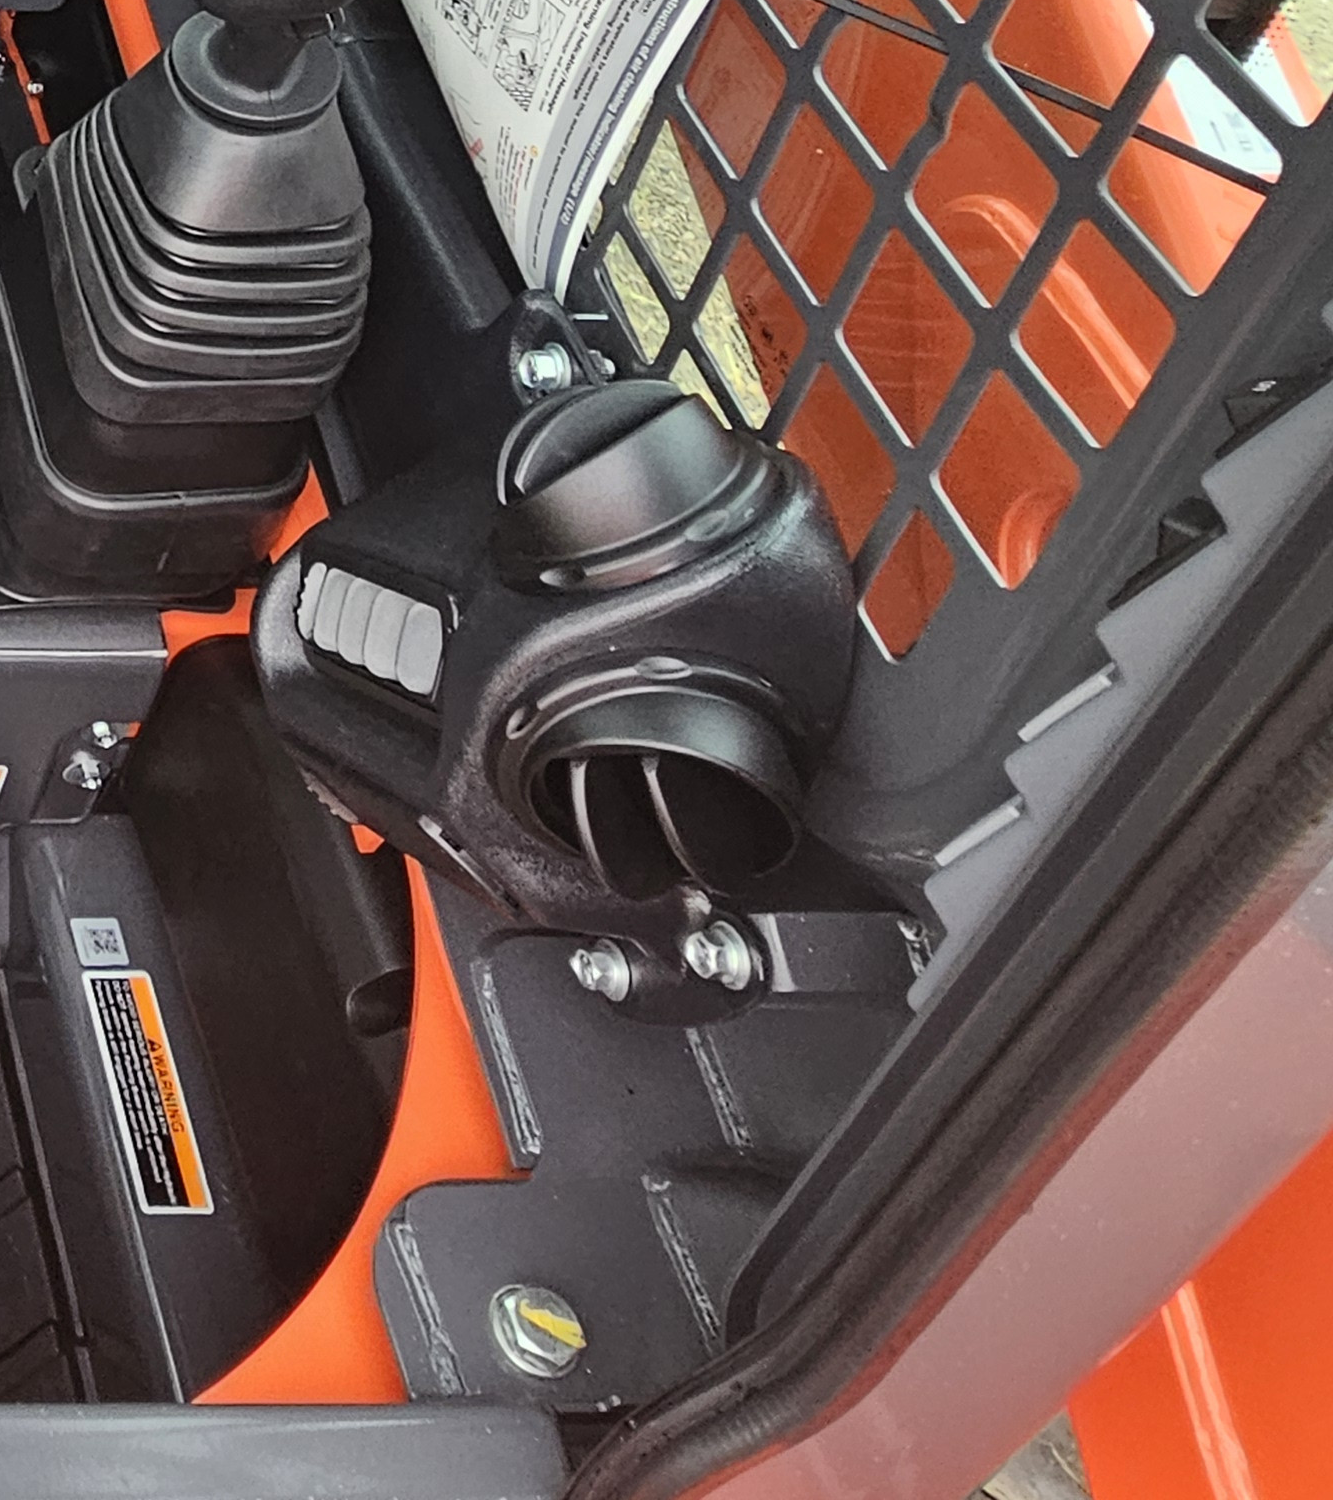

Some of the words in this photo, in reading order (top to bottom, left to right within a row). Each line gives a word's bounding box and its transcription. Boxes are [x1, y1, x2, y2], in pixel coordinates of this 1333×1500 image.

[622, 10, 633, 22] all
[601, 20, 626, 62] operators
[636, 44, 652, 60] of
[630, 57, 645, 74] air
[606, 70, 638, 114] cleaning
[574, 101, 587, 118] this
[152, 1053, 185, 1133] WARNING
